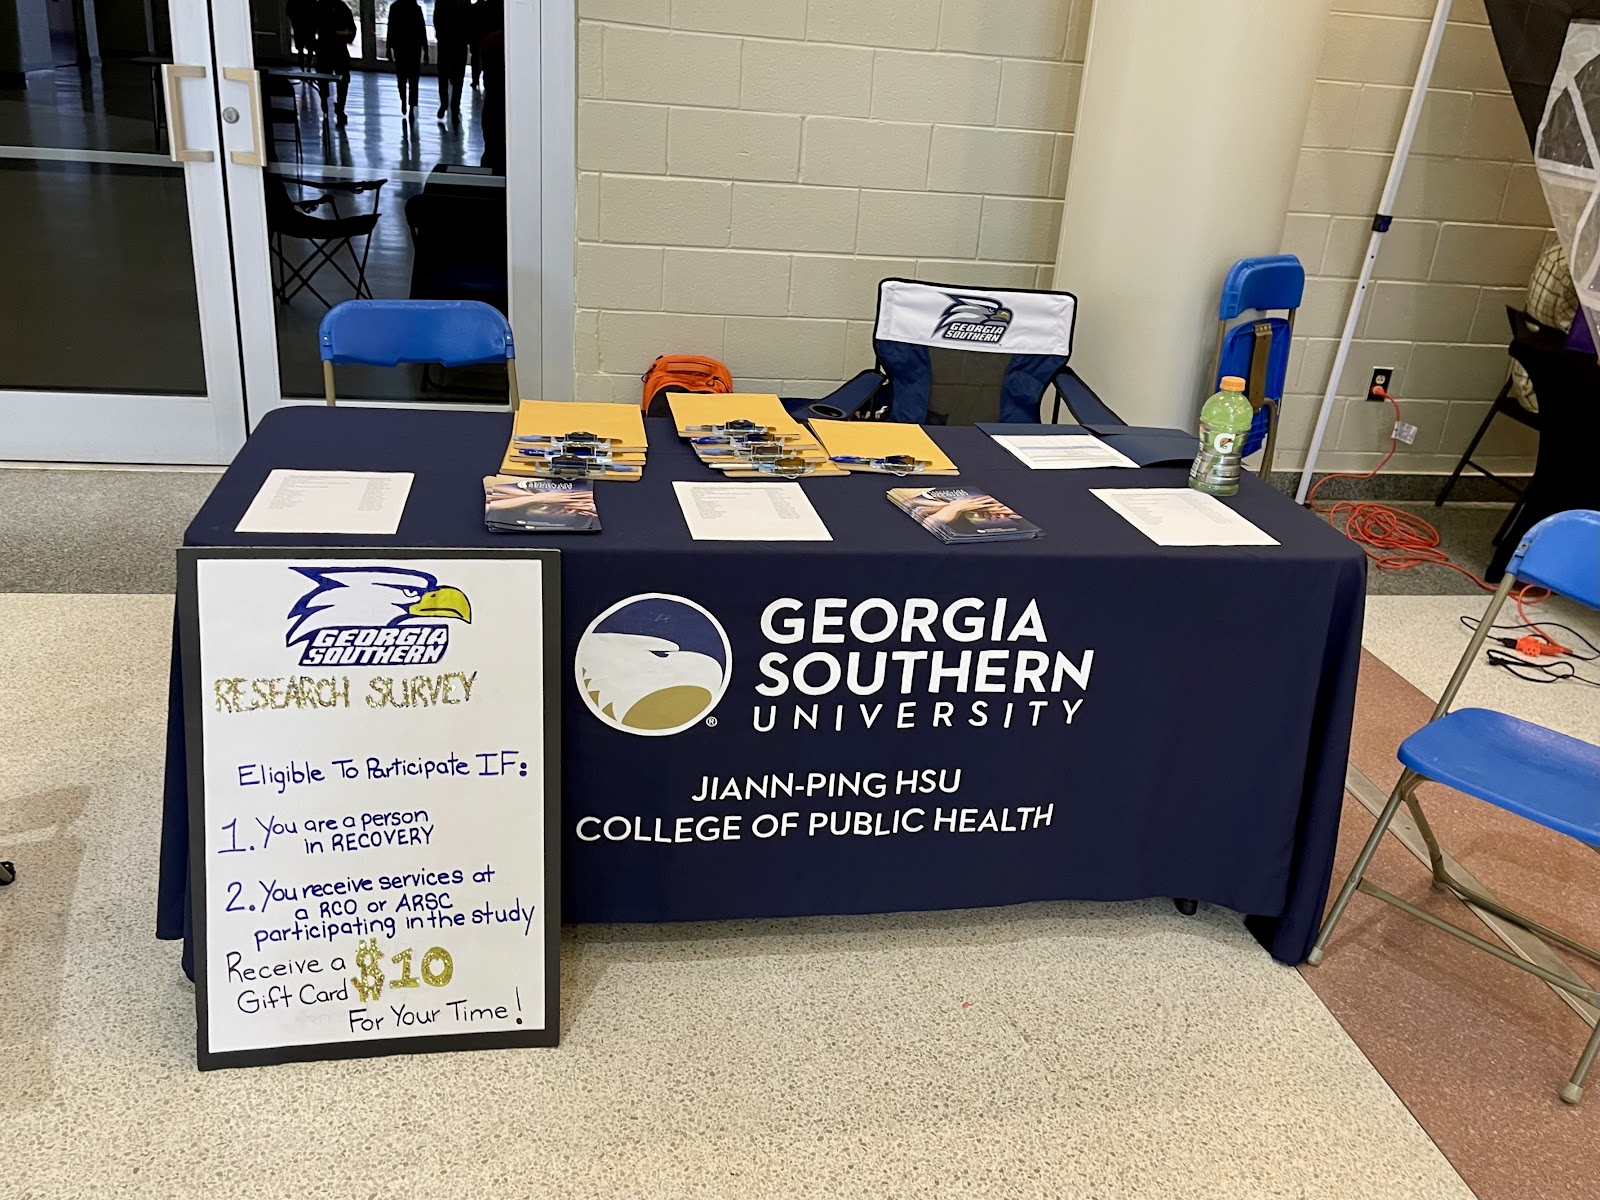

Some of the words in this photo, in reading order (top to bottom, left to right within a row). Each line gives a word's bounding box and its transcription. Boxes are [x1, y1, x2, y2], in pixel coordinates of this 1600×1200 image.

[944, 330, 1001, 342] SOUTHERN
[950, 323, 1004, 334] GEORGIA
[314, 627, 448, 647] GEORGIA
[761, 598, 1047, 644] GEORGIA
[302, 644, 445, 665] SOUTHERN
[755, 650, 1094, 696] SOUTHERN
[213, 674, 350, 713] RESEARCH
[365, 671, 478, 710] SURVEY
[754, 699, 1083, 732] UNIVERSITY
[238, 762, 325, 793] Eligible
[332, 759, 359, 780] To
[366, 751, 470, 779] Participate
[475, 750, 528, 777] IF:
[692, 772, 886, 801] JIANN-PING
[896, 769, 961, 794] HSU
[218, 818, 255, 854] 1.
[255, 815, 297, 849] You
[304, 817, 337, 832] are
[342, 816, 356, 828] a
[361, 809, 429, 835] person
[304, 838, 323, 855] in
[332, 825, 434, 852] RECOVERY
[576, 816, 741, 843] COLLEGE
[752, 812, 799, 838] OF
[809, 808, 925, 836] PUBLIC
[934, 804, 1053, 832] HEALTH
[225, 881, 256, 912] 2.
[258, 879, 297, 913] You
[302, 876, 373, 898] receive
[379, 866, 463, 890] services
[472, 865, 495, 884] at
[295, 907, 309, 921] a
[319, 899, 358, 919] RCO
[367, 898, 387, 913] or
[395, 892, 453, 913] ARSC
[254, 909, 396, 952] participating
[406, 909, 424, 929] in
[425, 907, 465, 927] the
[471, 898, 535, 936] study
[226, 951, 323, 984] Receive
[331, 957, 347, 970] a
[350, 938, 454, 1003] $10
[237, 985, 293, 1014] Gift
[299, 978, 349, 1004] Card
[349, 1008, 384, 1033] For
[390, 1003, 441, 1028] Your
